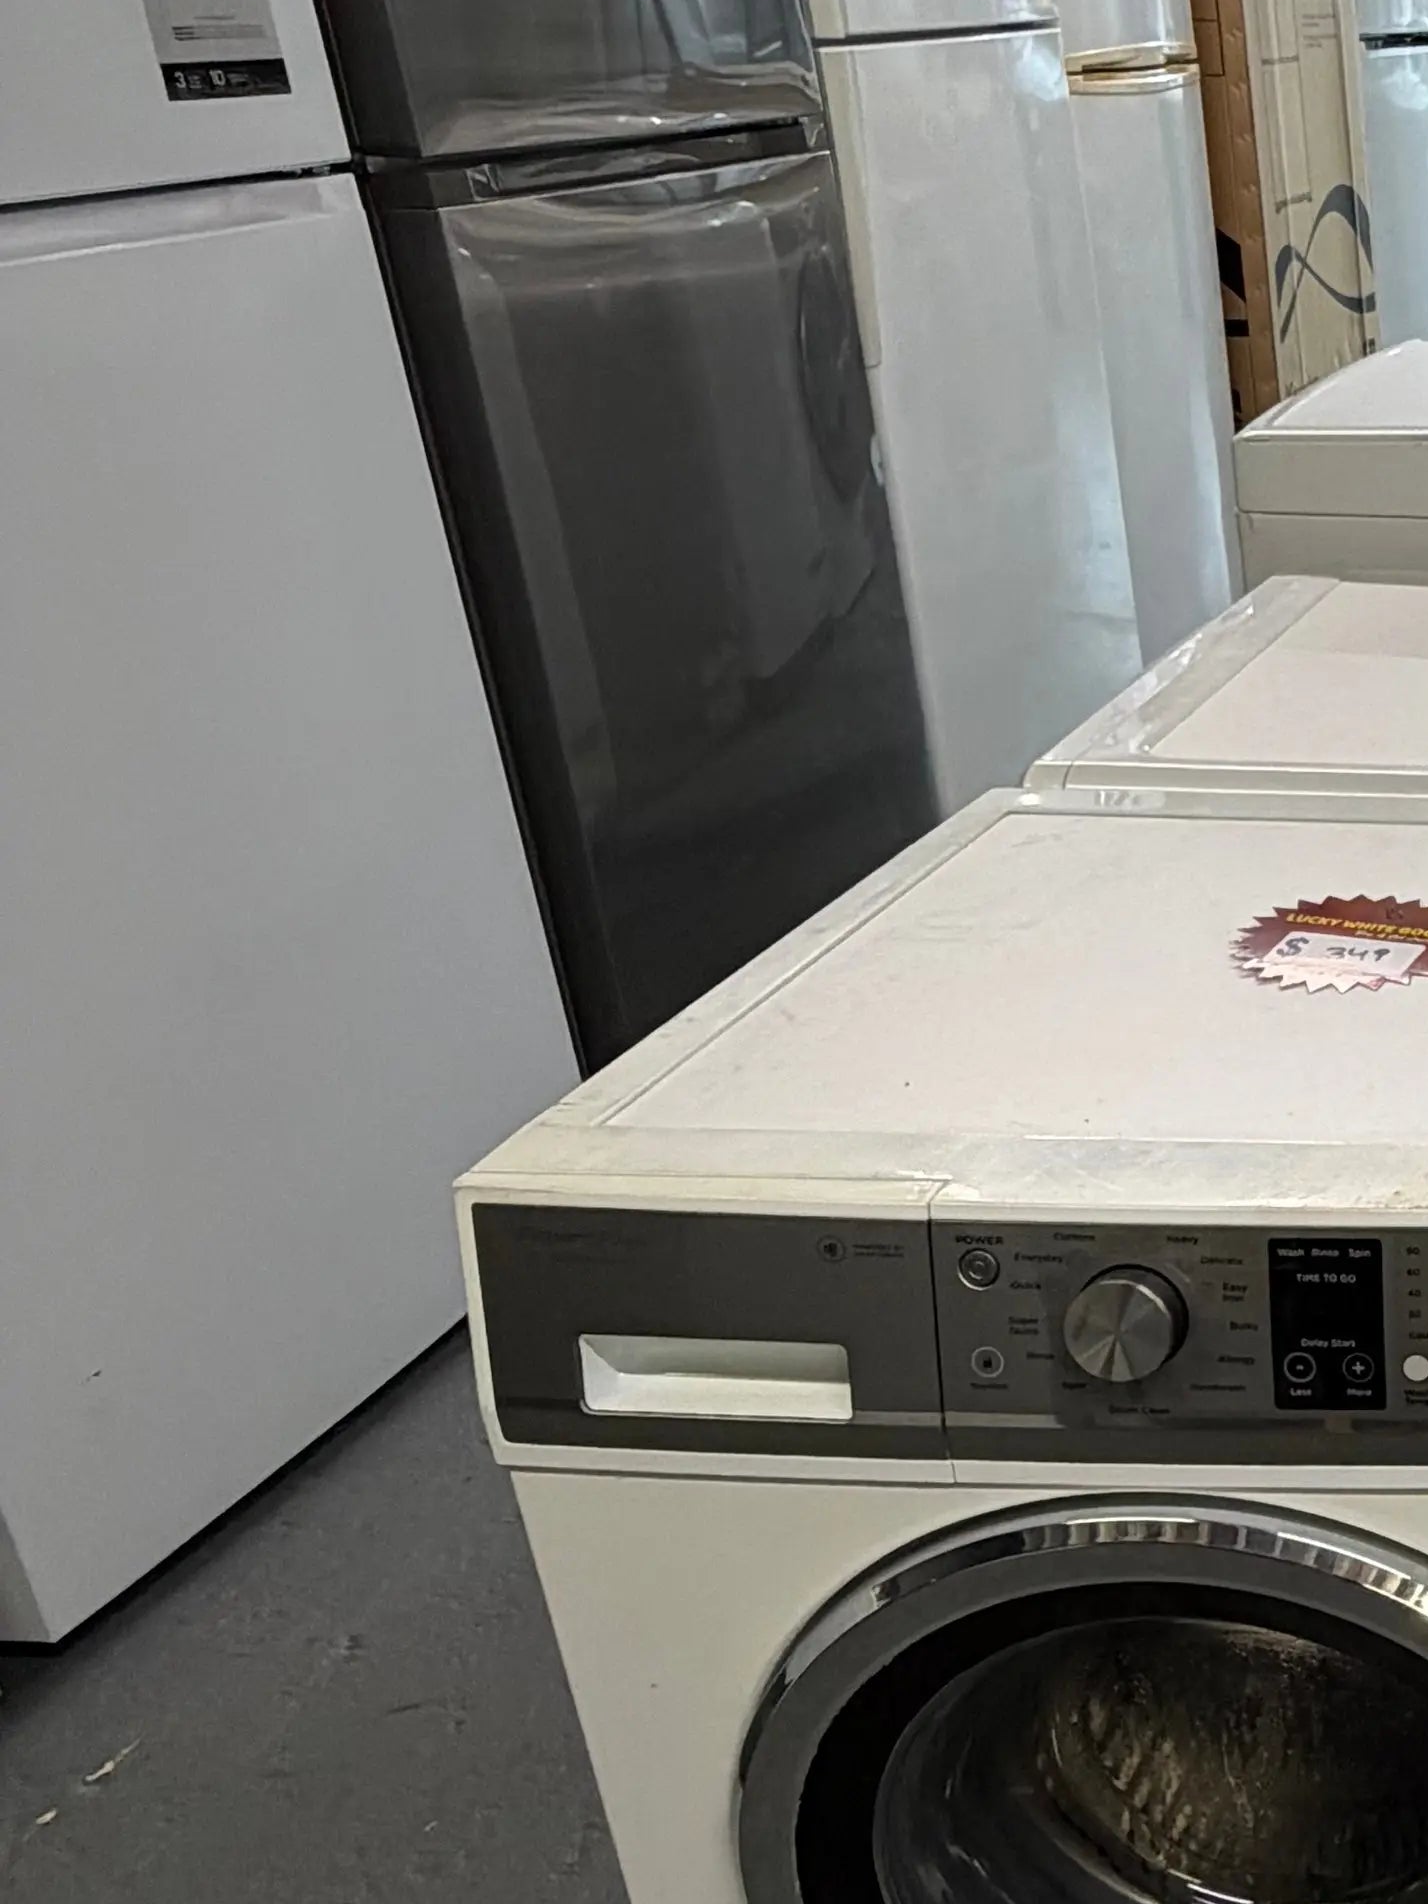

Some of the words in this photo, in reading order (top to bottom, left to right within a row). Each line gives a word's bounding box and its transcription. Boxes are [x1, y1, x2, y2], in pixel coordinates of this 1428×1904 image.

[1286, 912, 1342, 927] LUCKY
[1343, 919, 1398, 934] WHITE
[1276, 937, 1309, 958] $
[1326, 946, 1391, 962] 349
[955, 1234, 1004, 1246] POWER
[1296, 1273, 1320, 1283] TIME
[1323, 1273, 1337, 1283] TO
[1340, 1274, 1356, 1284] GO
